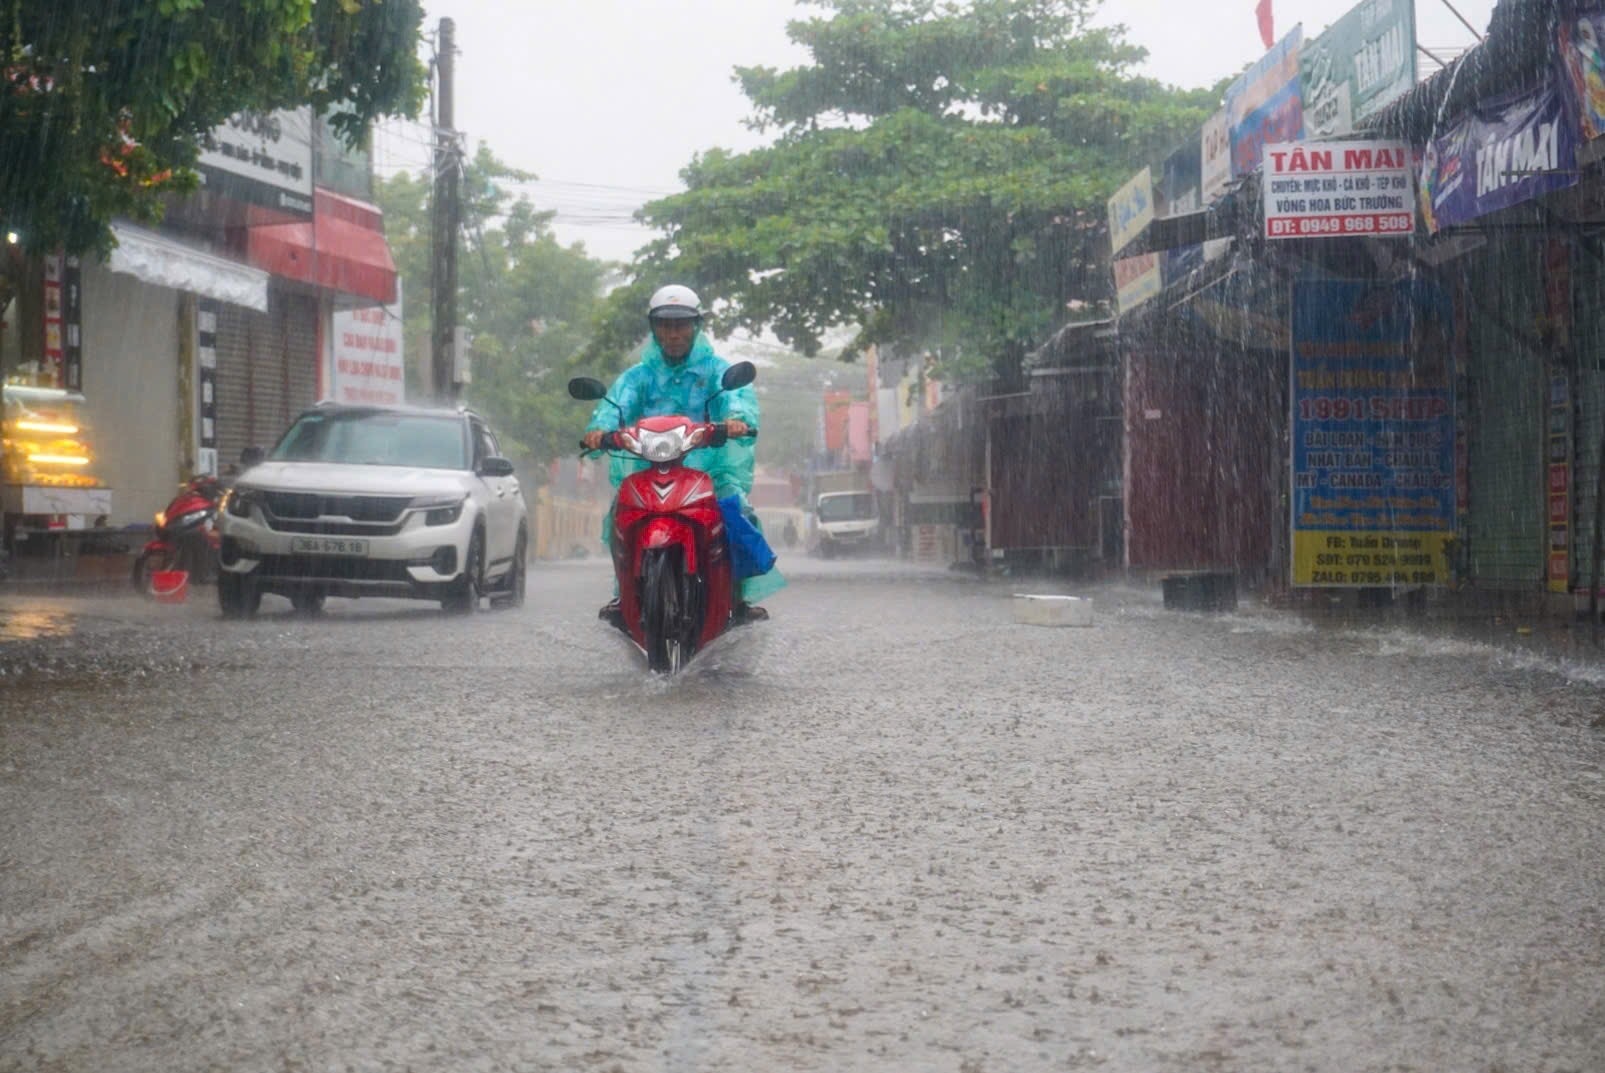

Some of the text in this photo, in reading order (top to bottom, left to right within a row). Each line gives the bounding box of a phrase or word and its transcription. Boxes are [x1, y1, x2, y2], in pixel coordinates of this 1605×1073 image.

[1270, 147, 1406, 172] TÂN MAI
[1277, 197, 1306, 213] VÒNG
[1309, 198, 1331, 212] HOA
[1272, 215, 1408, 234] ĐT: 0949 968 508
[1299, 396, 1366, 421] 1991
[1330, 473, 1382, 488] CANADA
